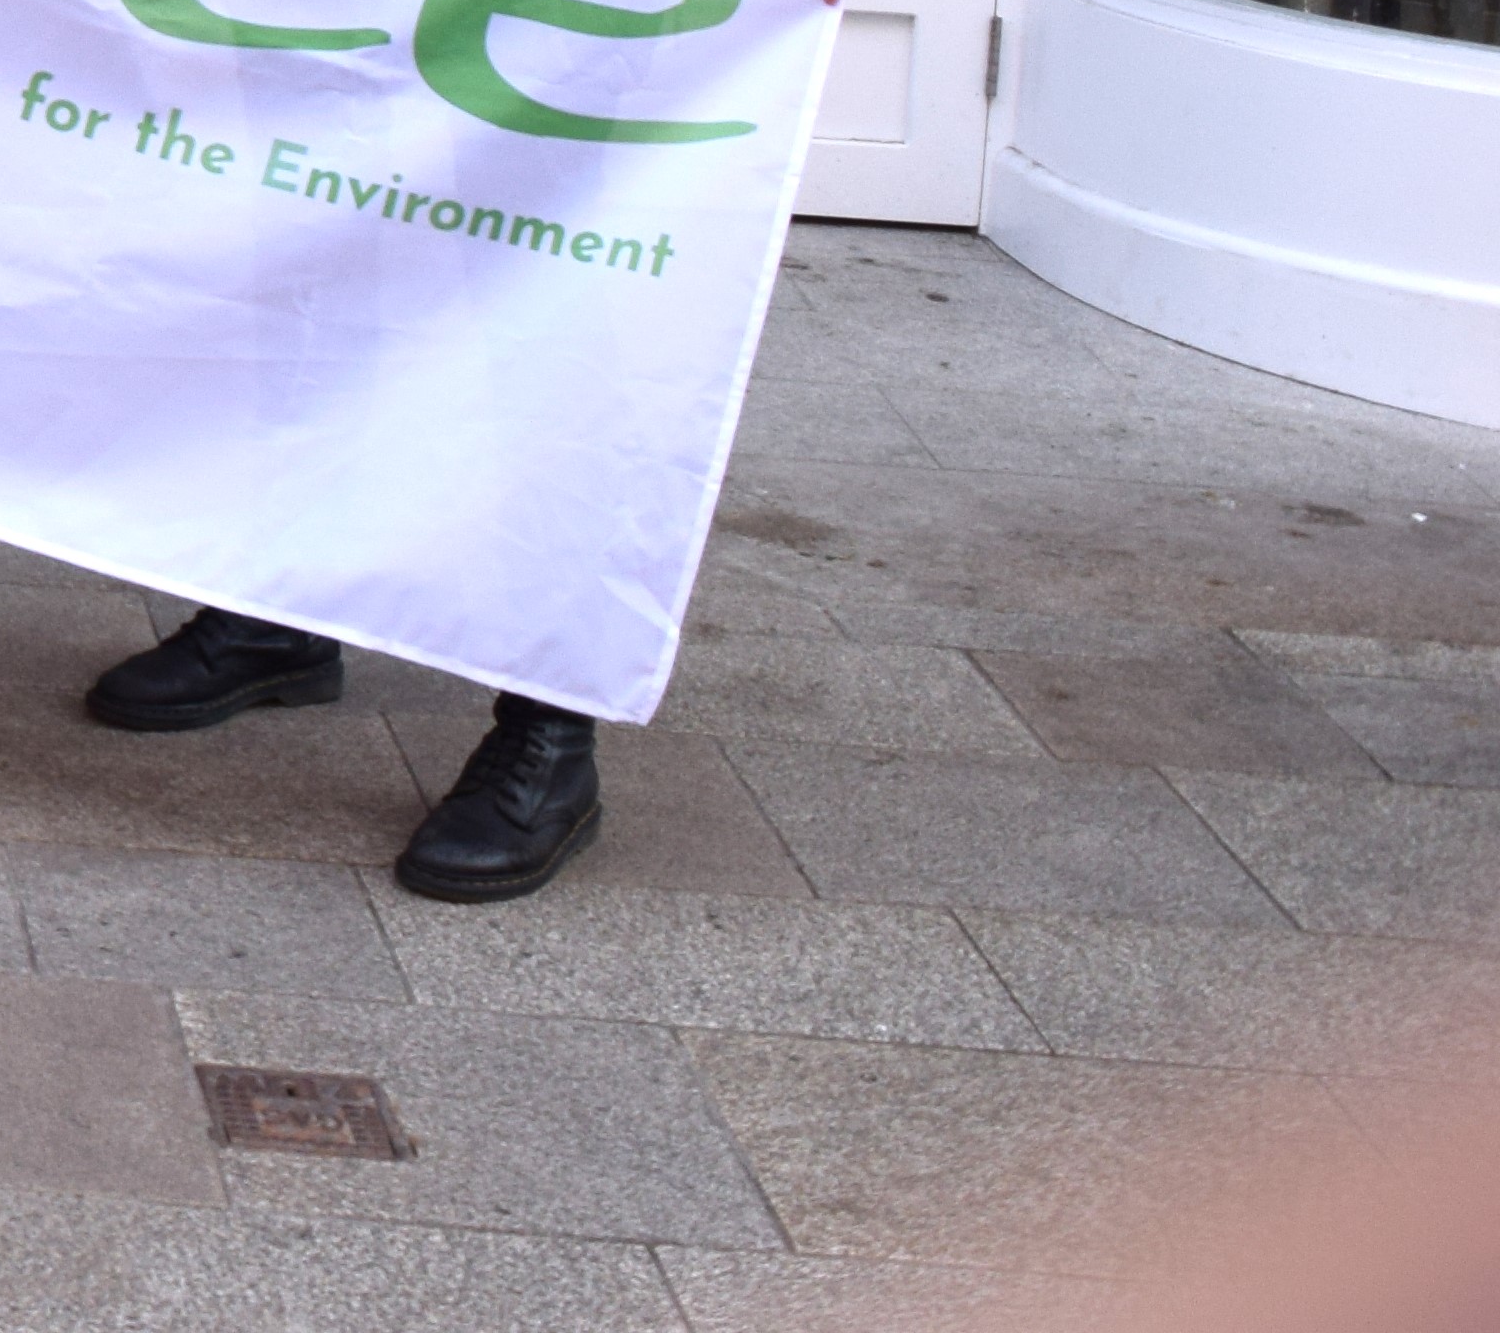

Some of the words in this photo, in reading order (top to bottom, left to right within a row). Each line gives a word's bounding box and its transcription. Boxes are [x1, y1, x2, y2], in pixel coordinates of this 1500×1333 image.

[20, 70, 111, 139] for
[135, 107, 235, 175] the
[260, 138, 675, 278] Environment
